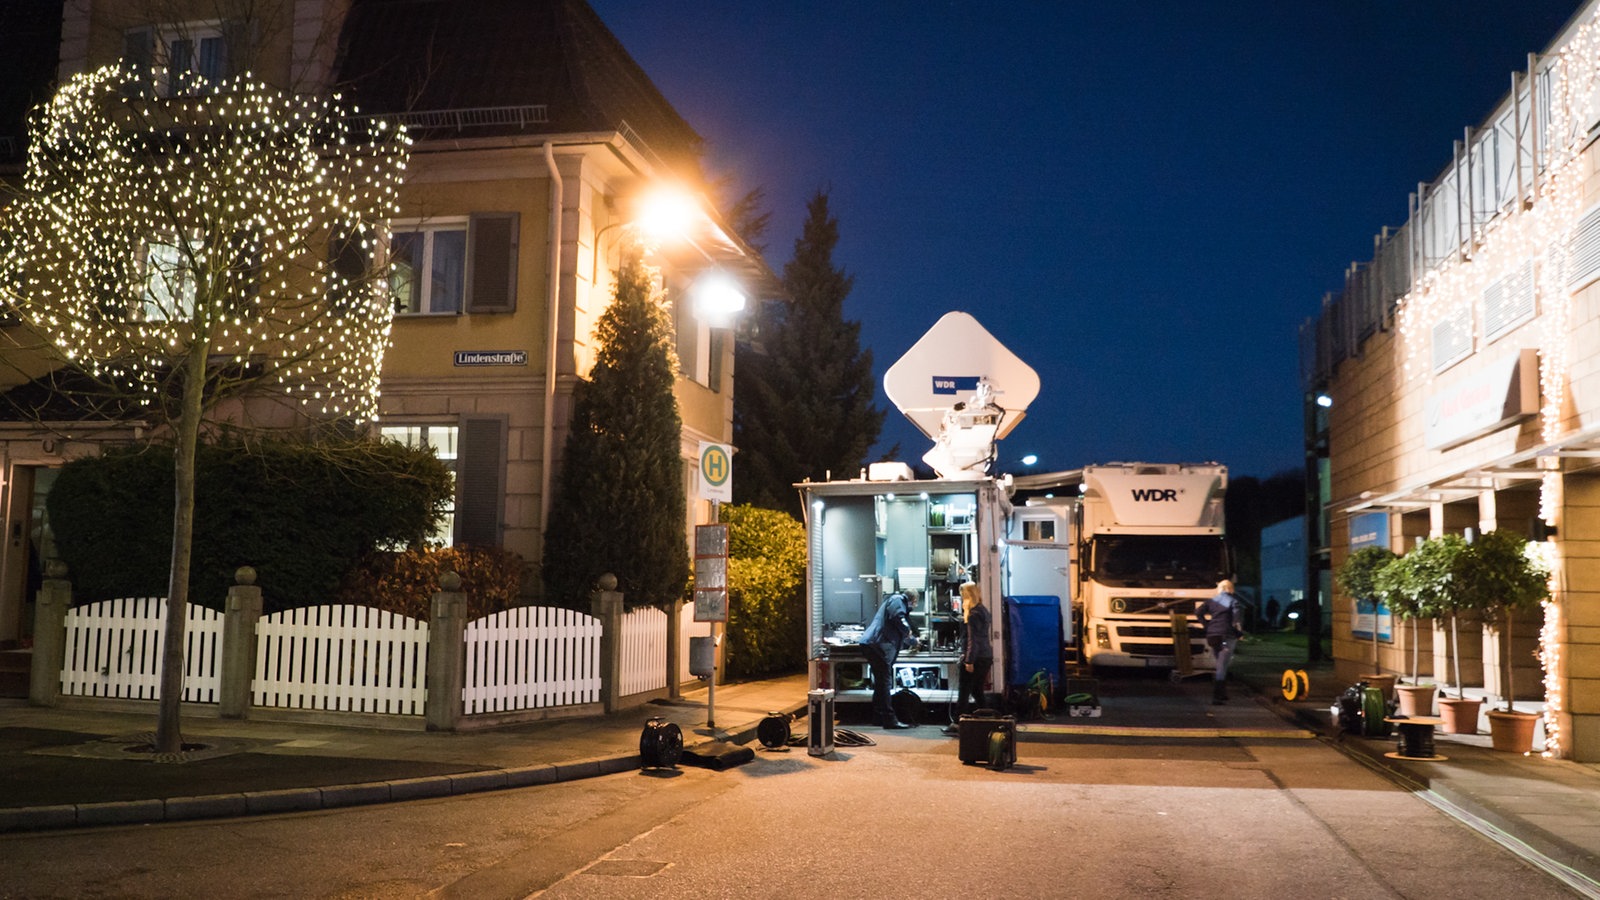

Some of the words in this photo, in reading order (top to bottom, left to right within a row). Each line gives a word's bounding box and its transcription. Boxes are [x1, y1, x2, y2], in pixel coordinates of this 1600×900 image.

[459, 353, 524, 364] Lindenstraße
[934, 381, 956, 389] WDR
[709, 454, 722, 477] H
[1131, 489, 1177, 502] WDR
